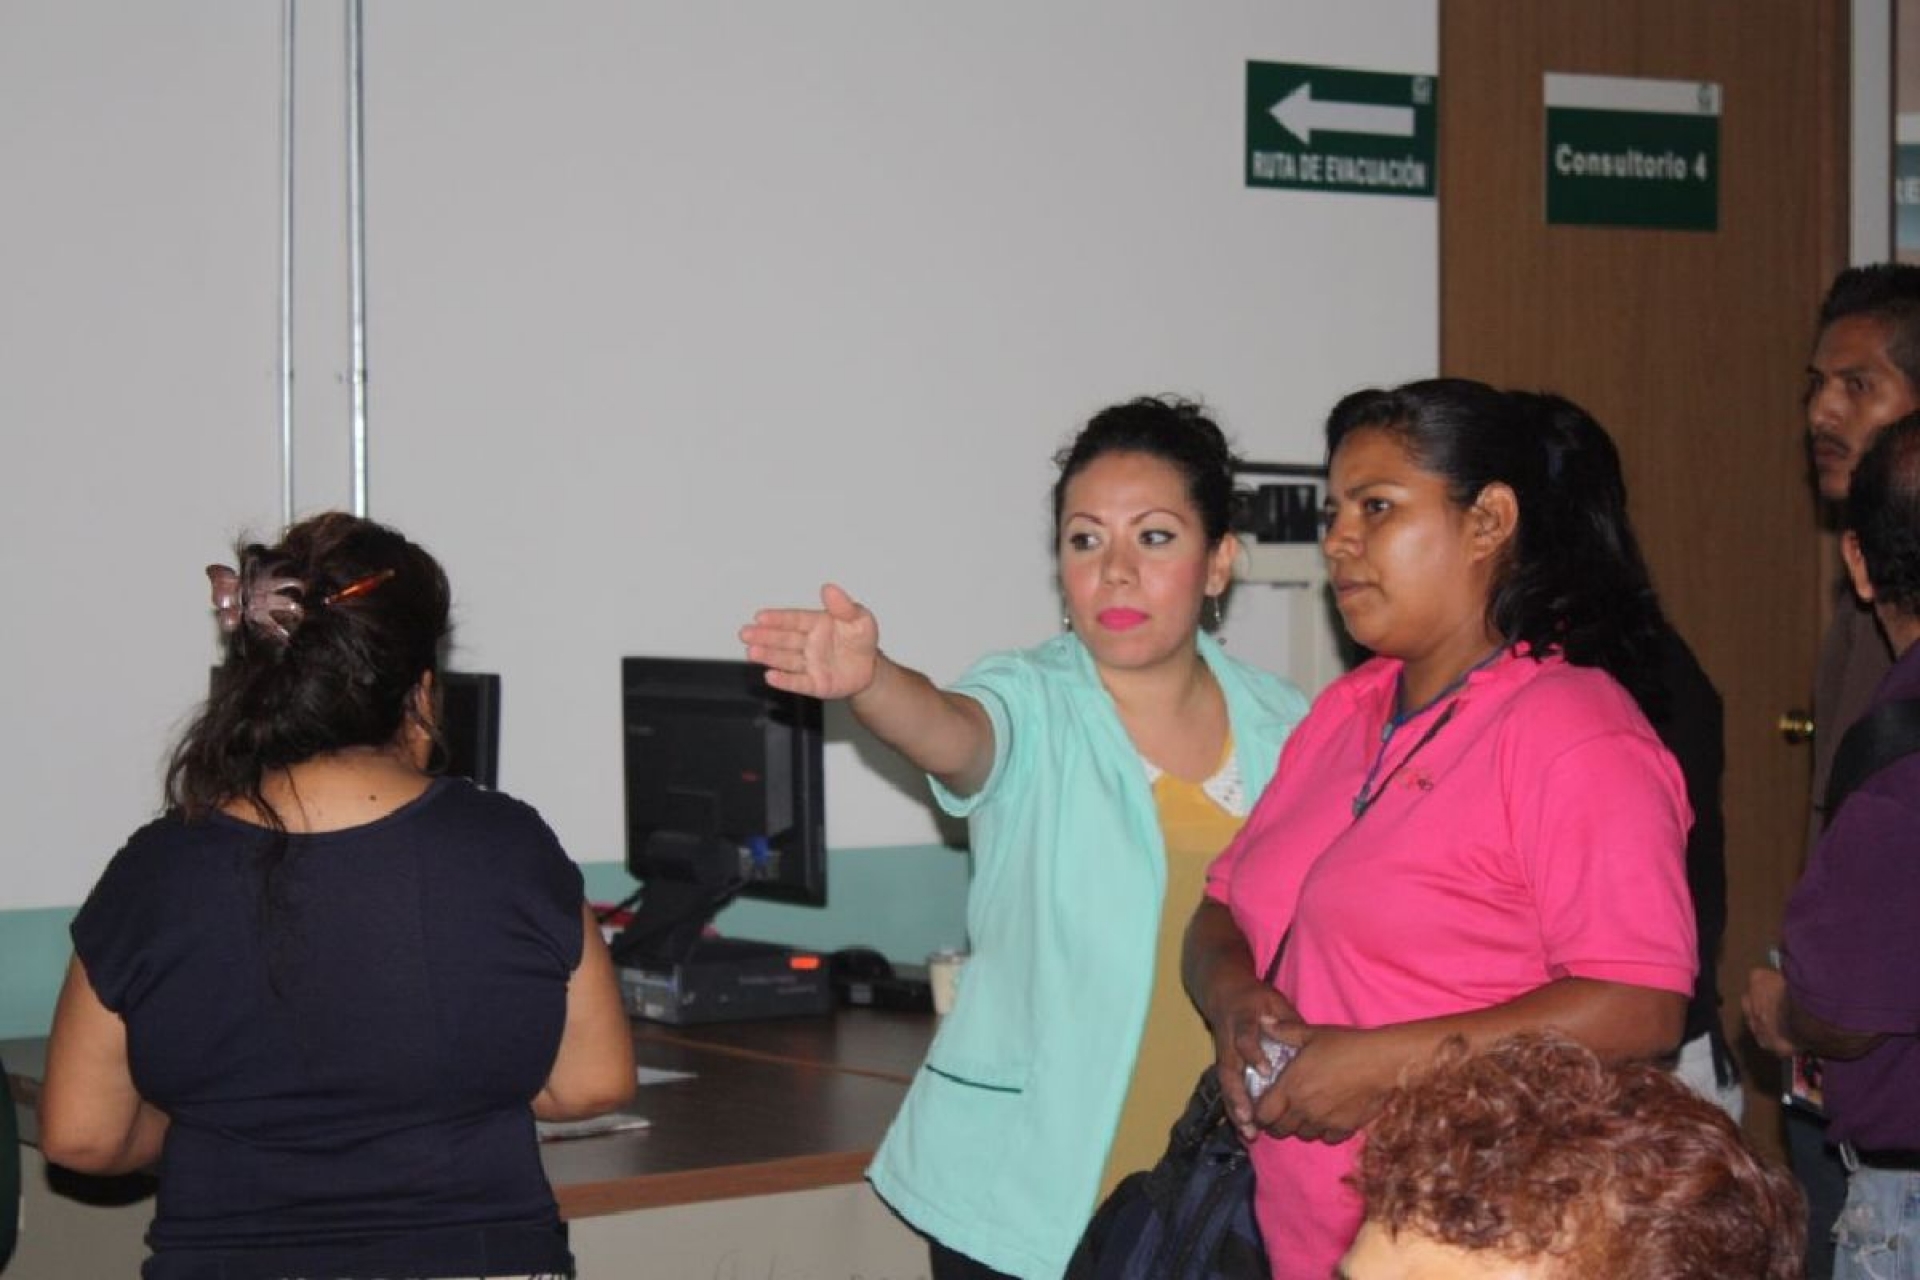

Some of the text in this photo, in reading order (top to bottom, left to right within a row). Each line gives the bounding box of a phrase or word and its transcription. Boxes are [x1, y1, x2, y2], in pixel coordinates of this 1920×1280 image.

[1252, 151, 1426, 187] RUTA DE EVACUACIÓN
[1555, 144, 1707, 182] Consultorio 4
